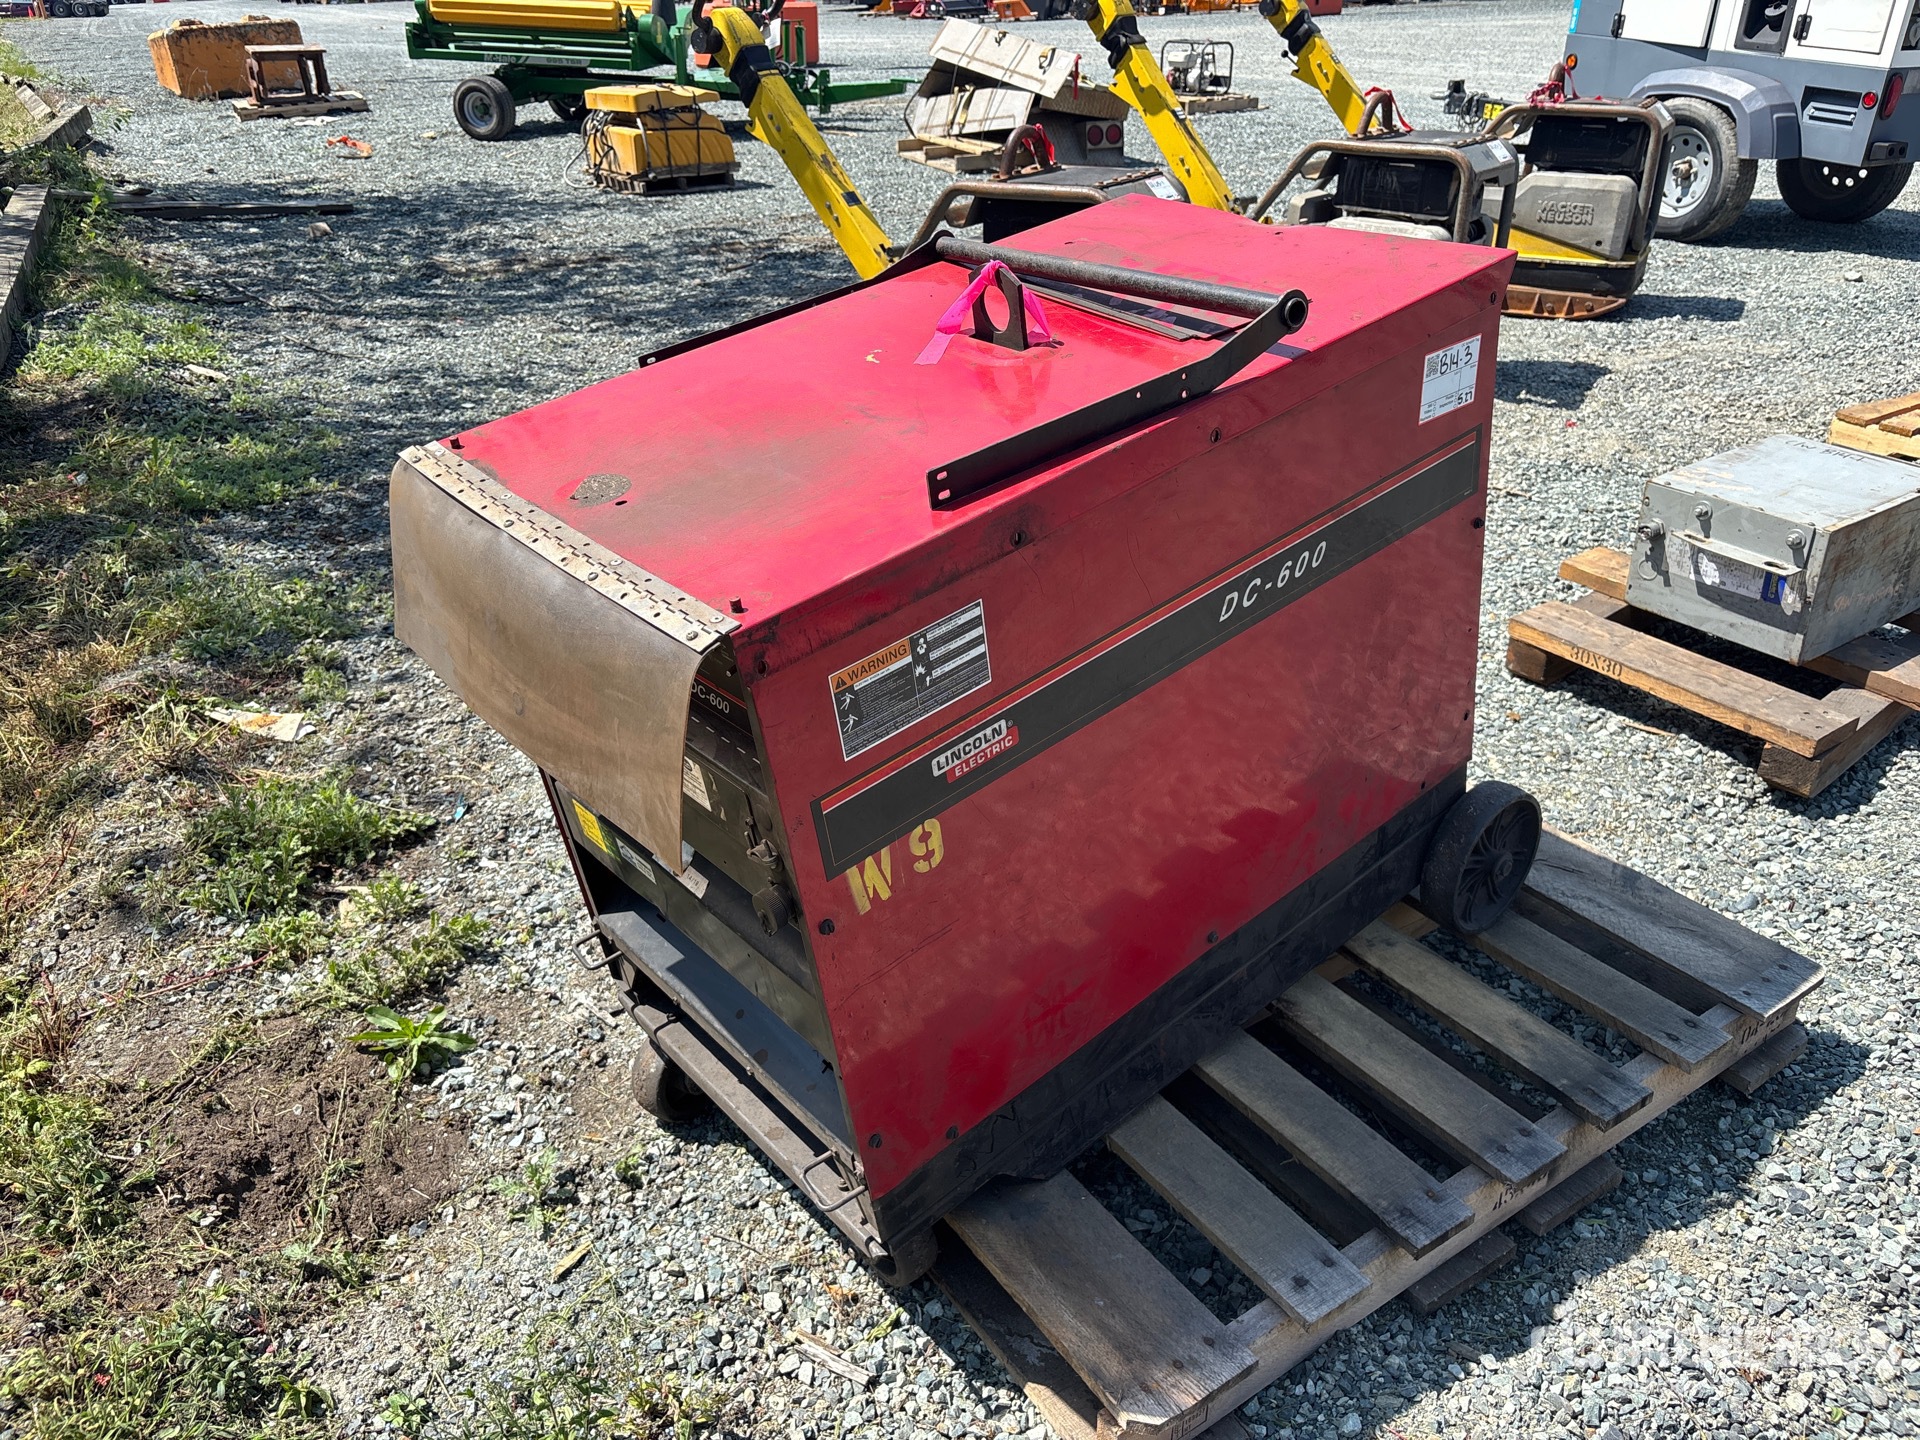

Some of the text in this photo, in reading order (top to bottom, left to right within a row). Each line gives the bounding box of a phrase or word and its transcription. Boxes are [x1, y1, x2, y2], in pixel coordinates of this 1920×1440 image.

[1536, 209, 1594, 226] NEUSON
[1537, 200, 1594, 214] WACKER
[1219, 540, 1327, 623] DC-600
[847, 643, 908, 682] WARNING
[691, 681, 730, 714] DC-600
[935, 723, 1004, 772] LINCOLN
[954, 736, 1014, 778] ELECTRIC
[908, 817, 945, 874] 9
